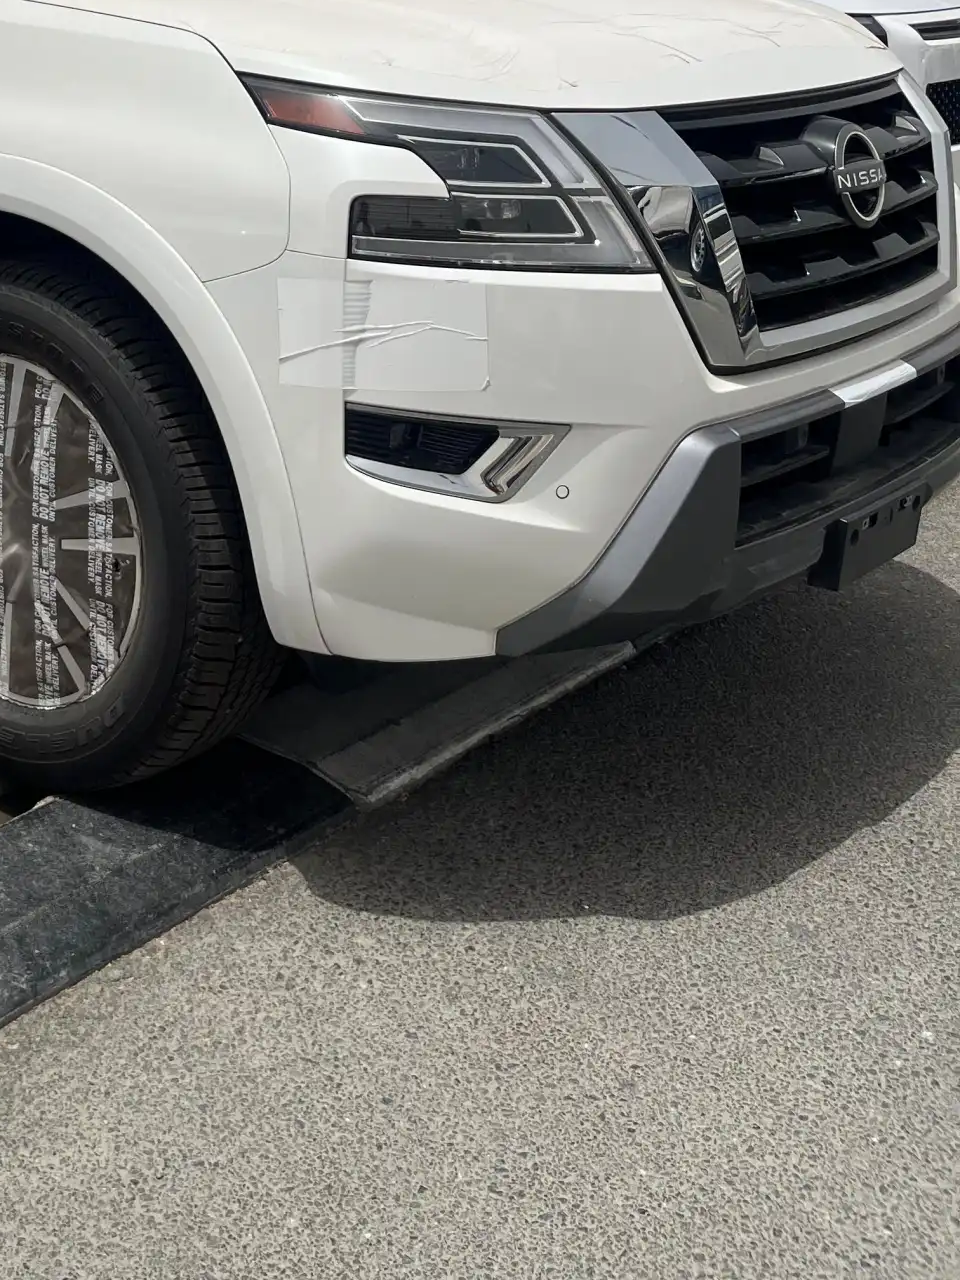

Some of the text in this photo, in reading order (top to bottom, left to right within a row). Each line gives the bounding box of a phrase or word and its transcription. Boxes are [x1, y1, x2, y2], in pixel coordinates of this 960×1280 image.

[837, 167, 887, 189] NISSA
[40, 450, 49, 485] REMOVE
[95, 454, 103, 475] MASK
[95, 479, 106, 492] DO
[40, 488, 49, 505] NOT
[95, 494, 106, 511] NOT
[40, 507, 49, 519] DO
[95, 514, 106, 551] REMOVE
[96, 600, 105, 612] DO
[97, 614, 106, 633] NOT
